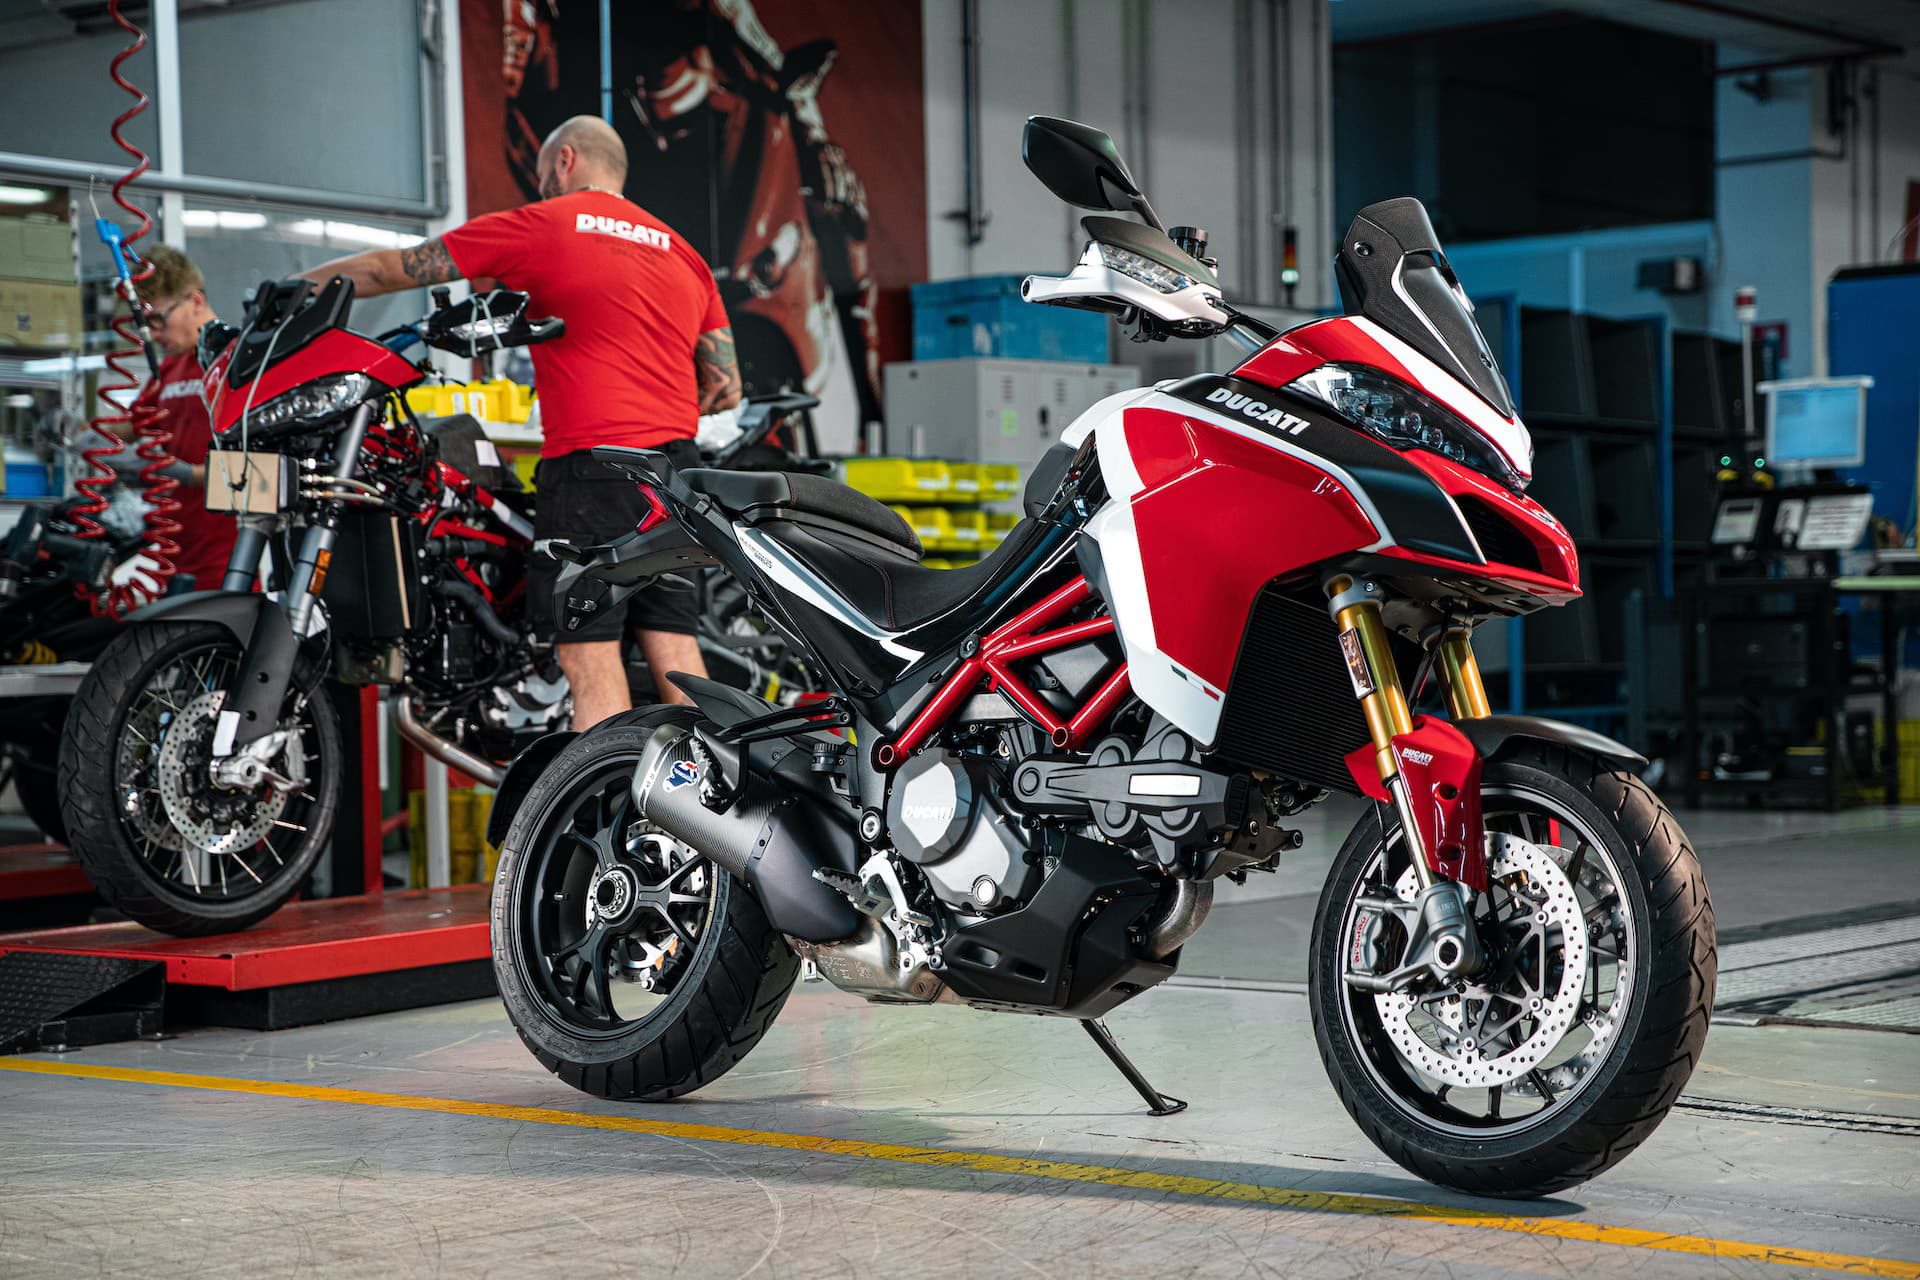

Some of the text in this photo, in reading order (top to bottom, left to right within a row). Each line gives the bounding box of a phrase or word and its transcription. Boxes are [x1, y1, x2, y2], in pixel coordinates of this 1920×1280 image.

[575, 213, 671, 251] DUCATI
[1205, 387, 1311, 435] DUCATI
[1402, 747, 1433, 763] DUCATI
[903, 804, 954, 820] DUCATI
